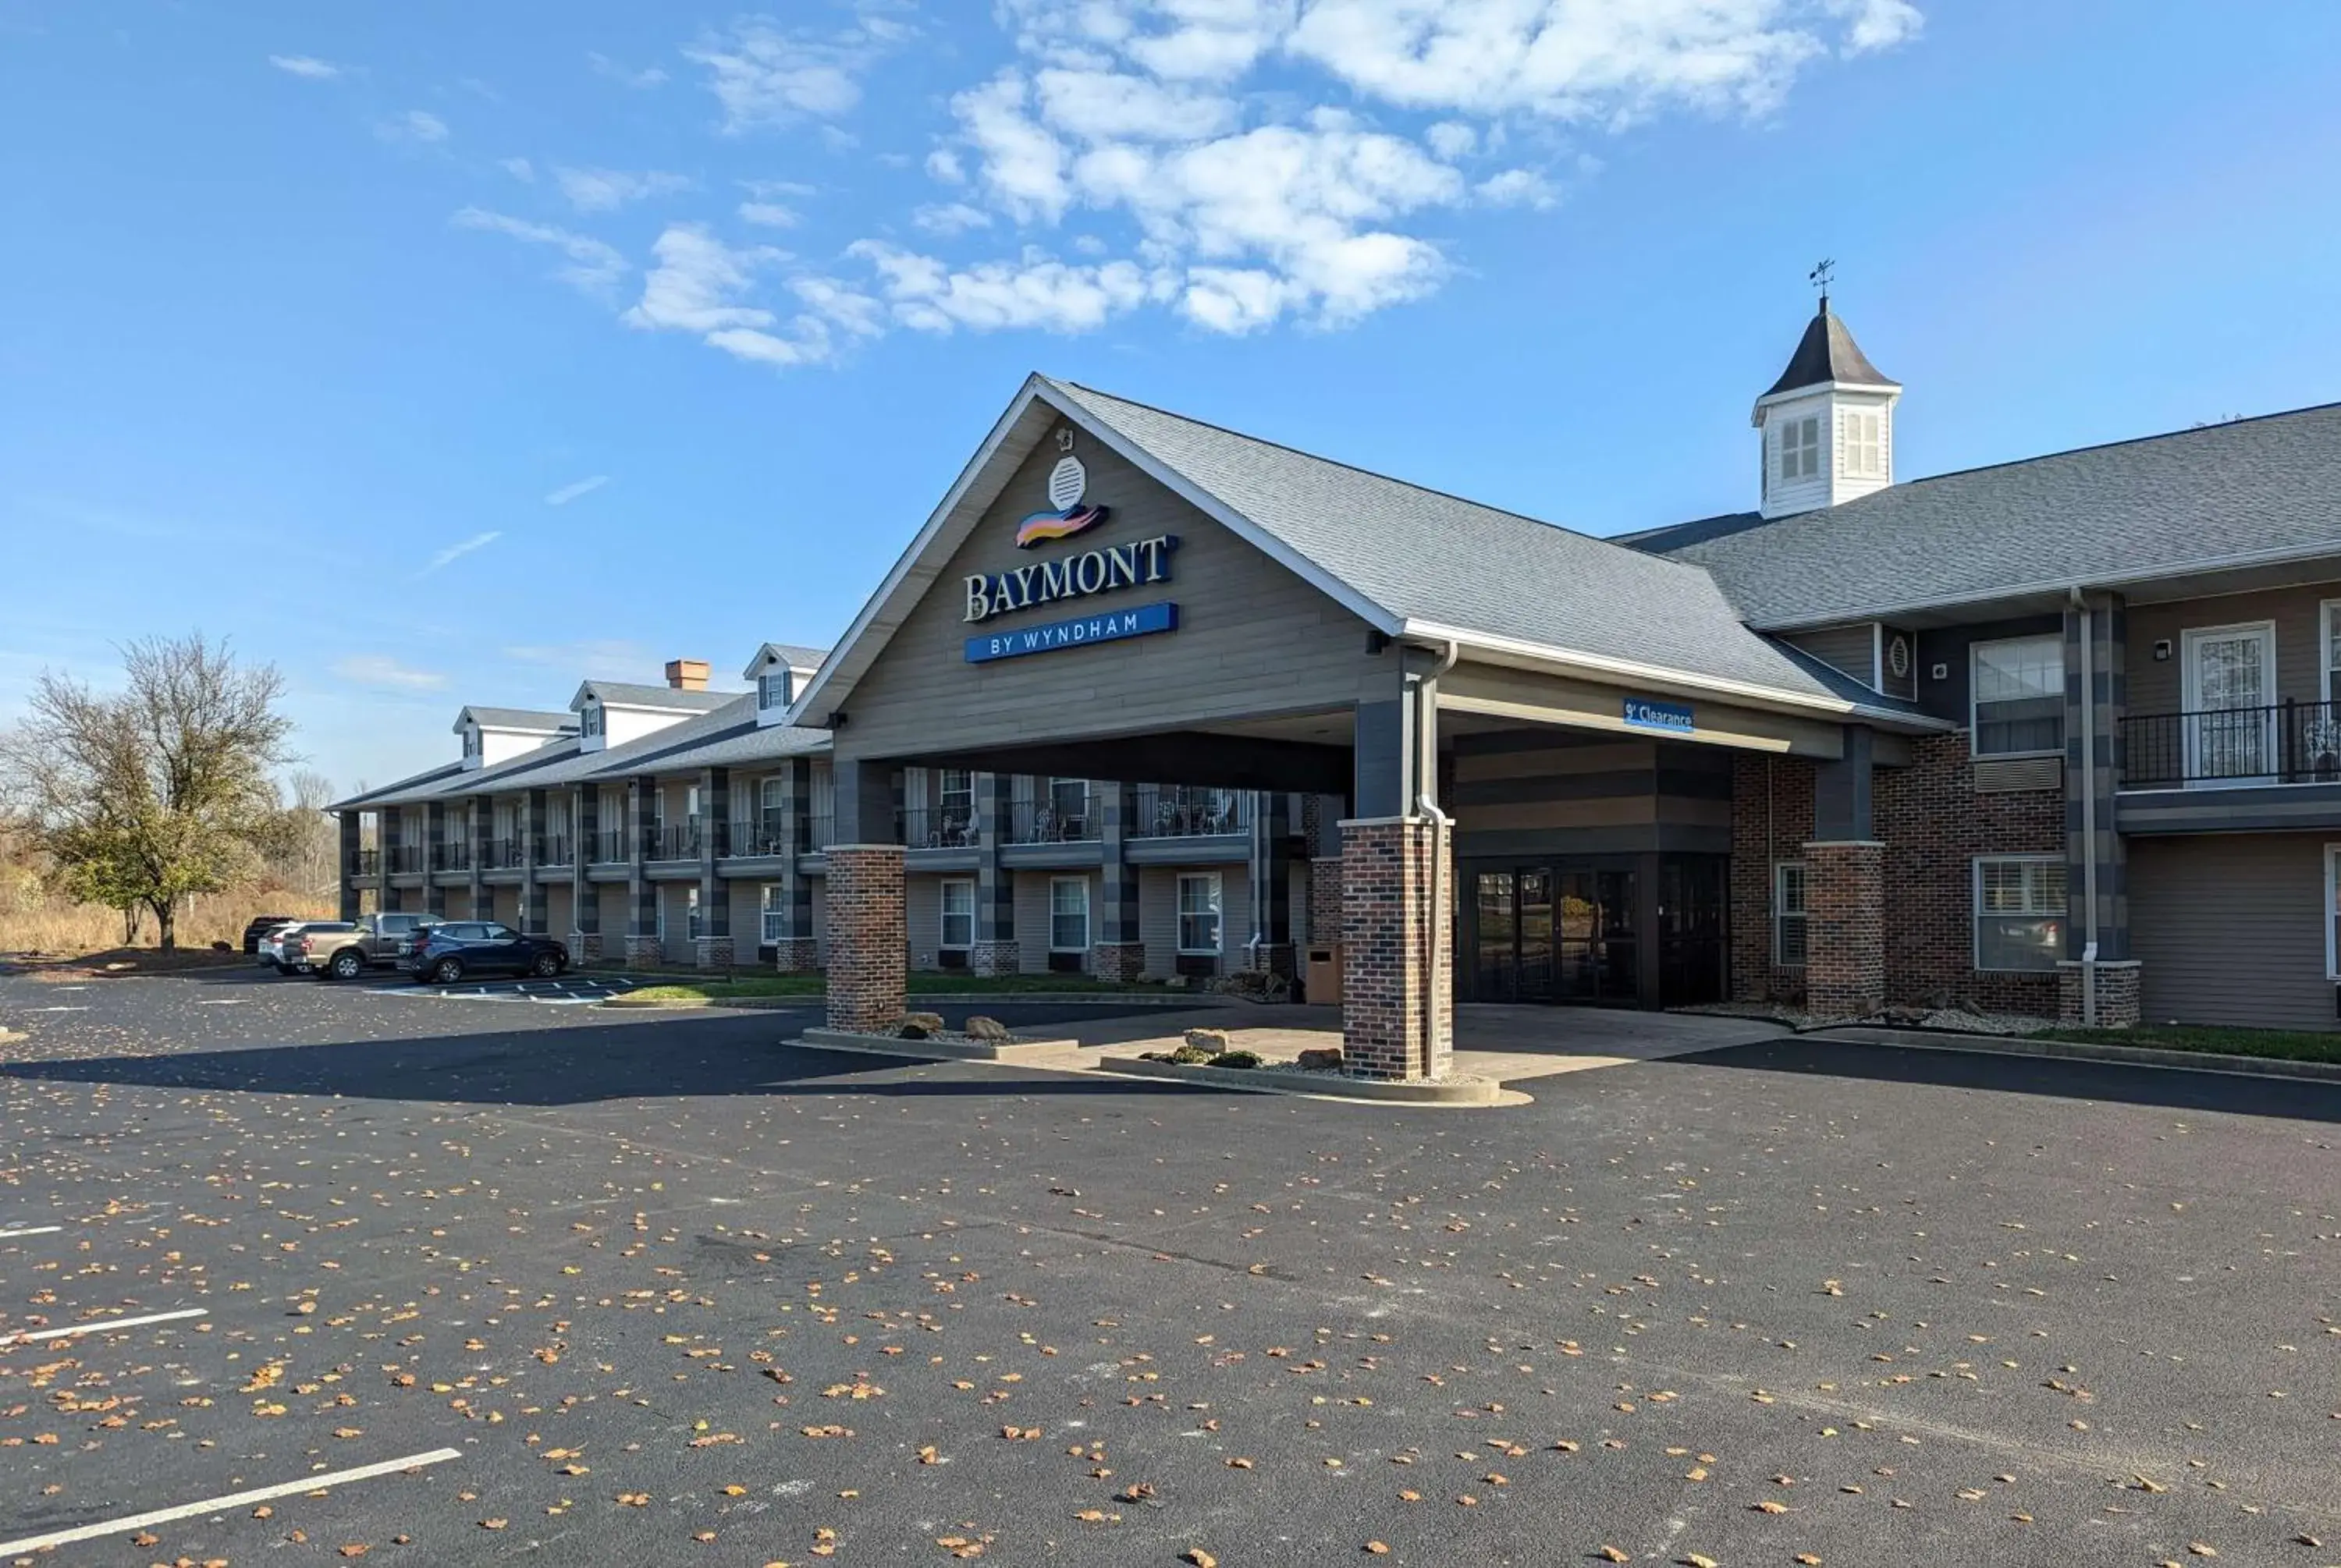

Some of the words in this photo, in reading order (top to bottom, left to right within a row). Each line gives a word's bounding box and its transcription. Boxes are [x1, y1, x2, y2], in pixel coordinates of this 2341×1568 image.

[963, 535, 1169, 622] BAYMONT
[990, 636, 1013, 655] BY
[1024, 614, 1137, 649] WYNDHAM
[1639, 705, 1693, 726] Clearance
